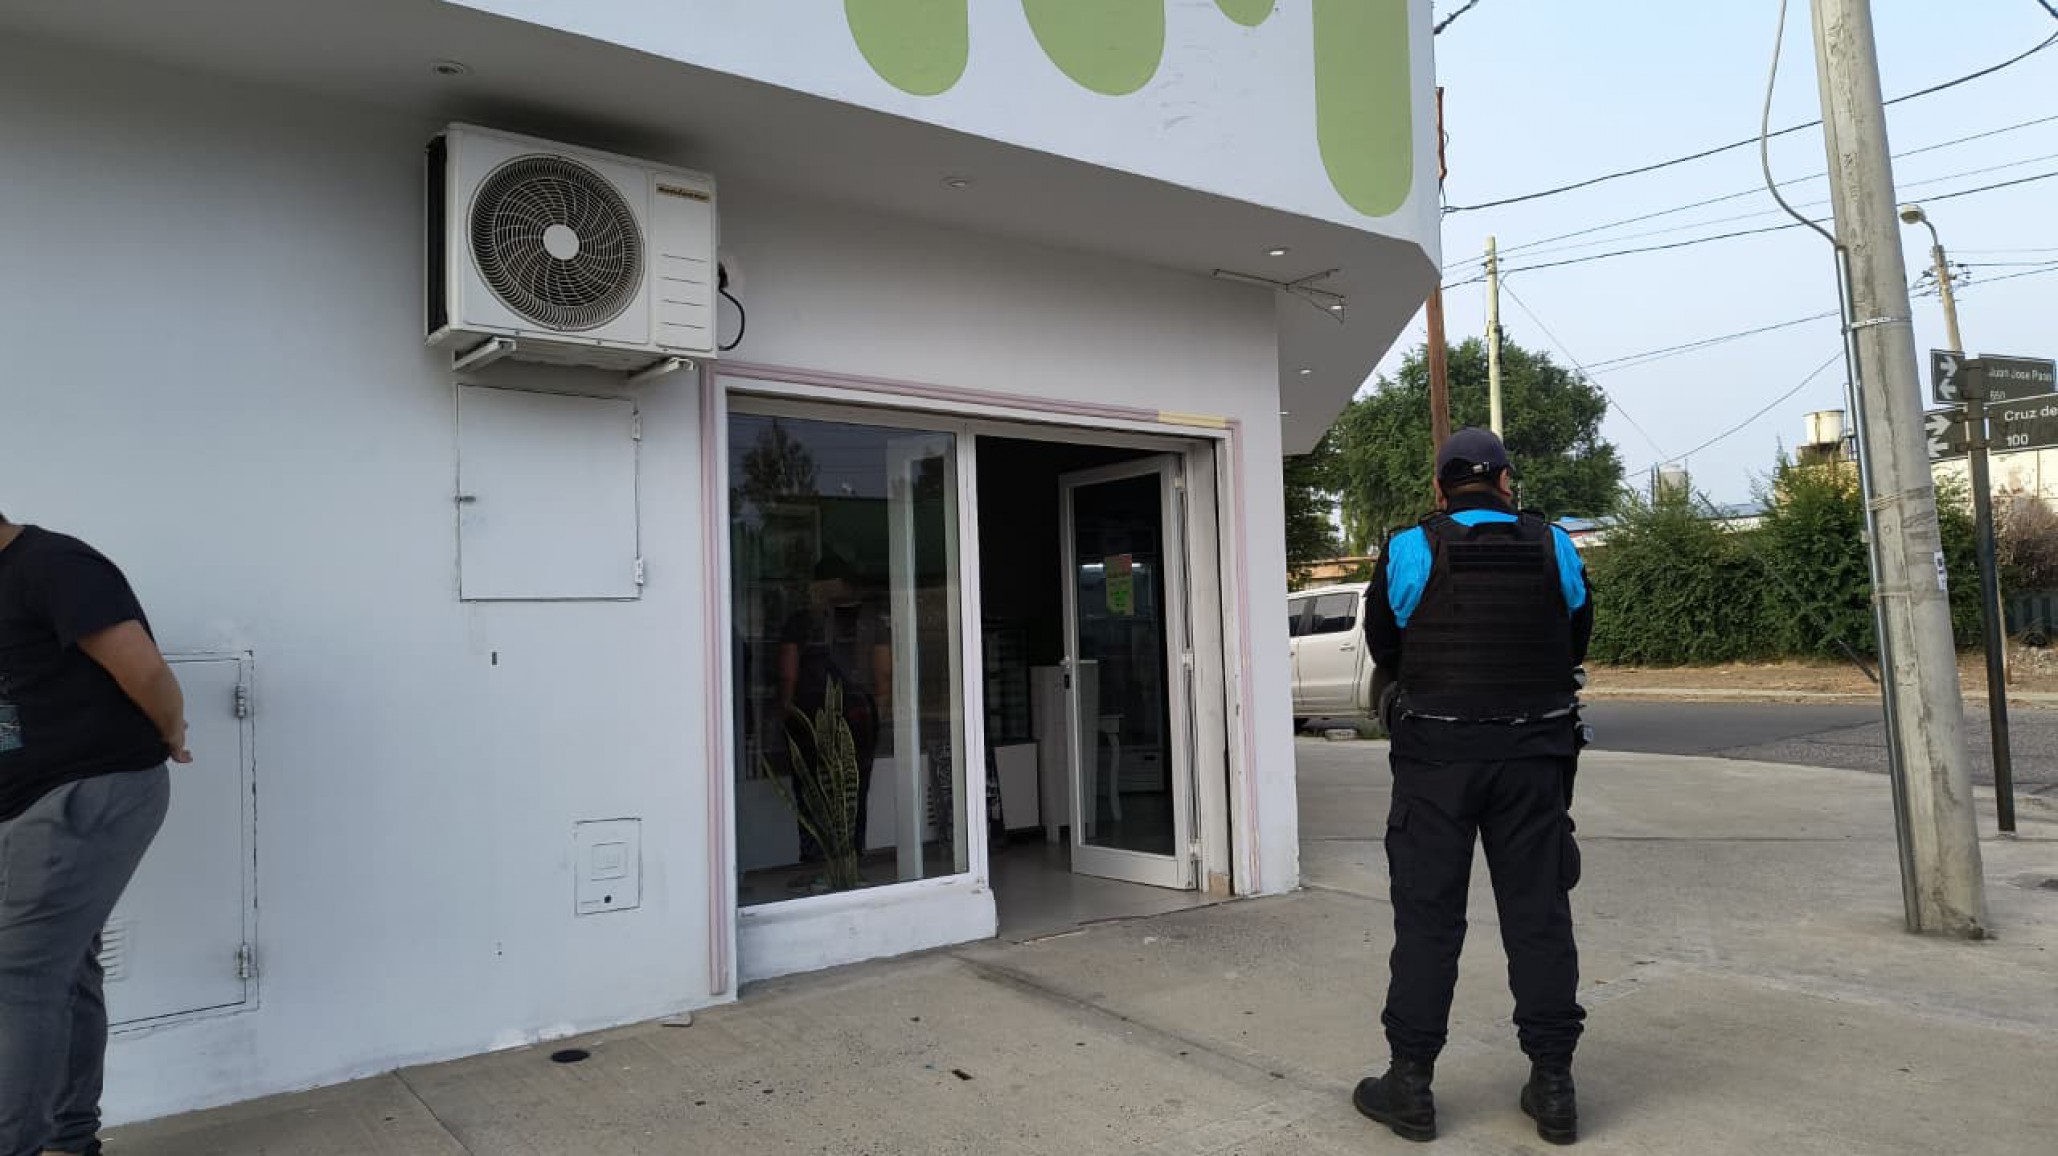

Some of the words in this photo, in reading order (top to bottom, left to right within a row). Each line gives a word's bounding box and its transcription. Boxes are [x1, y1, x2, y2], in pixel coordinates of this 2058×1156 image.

[1989, 367, 2009, 378] Juan
[2010, 369, 2030, 381] Jose
[2004, 410, 2038, 422] Cruz
[2040, 405, 2058, 418] de
[2006, 433, 2029, 447] 100
